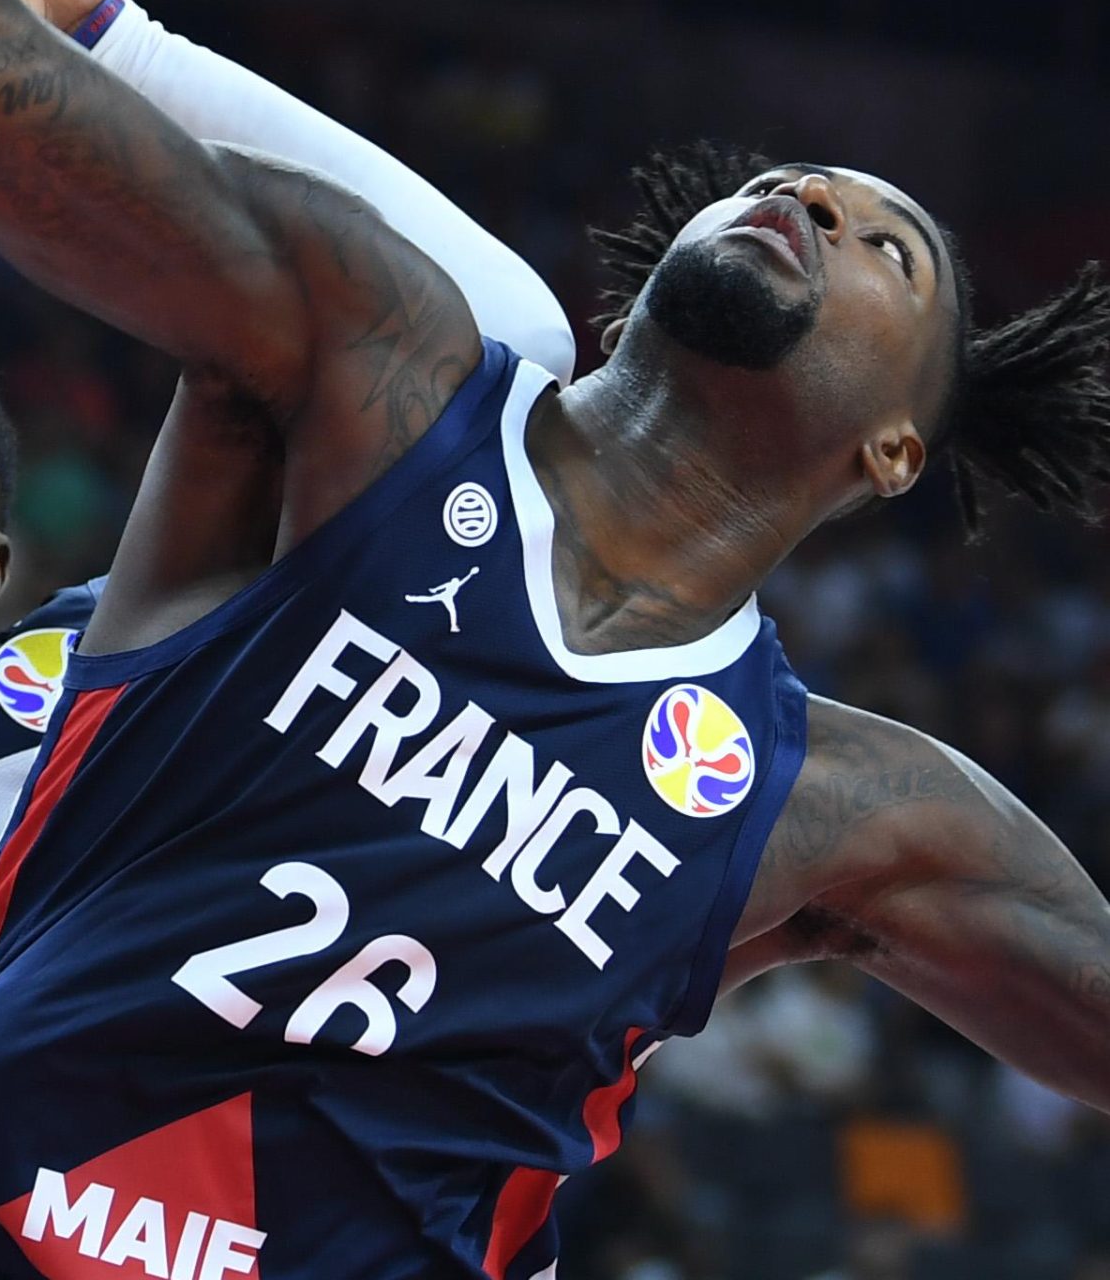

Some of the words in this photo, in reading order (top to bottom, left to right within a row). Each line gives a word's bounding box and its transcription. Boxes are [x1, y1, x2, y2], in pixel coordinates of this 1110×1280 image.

[263, 608, 682, 971] FRANCE
[171, 861, 438, 1057] 26
[21, 1167, 268, 1280] MAIF
